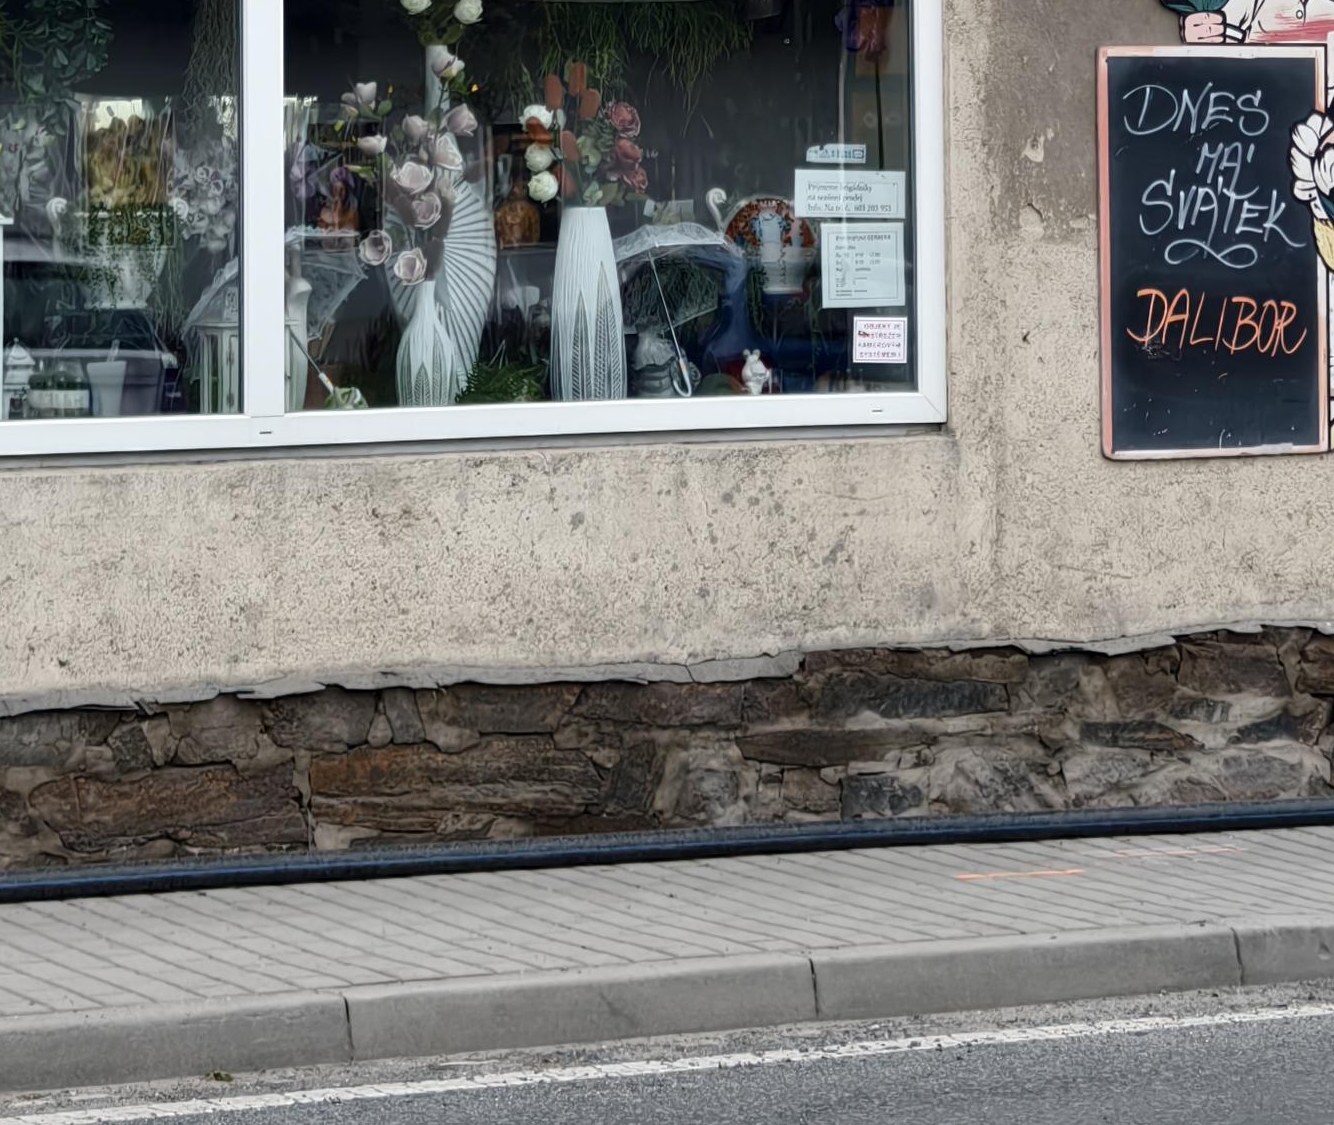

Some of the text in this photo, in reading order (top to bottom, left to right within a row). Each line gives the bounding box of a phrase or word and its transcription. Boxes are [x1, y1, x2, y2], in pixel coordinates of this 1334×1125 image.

[1122, 82, 1270, 136] DNES
[1139, 169, 1307, 249] SVÁTEK
[1127, 289, 1307, 357] DALIBOR
